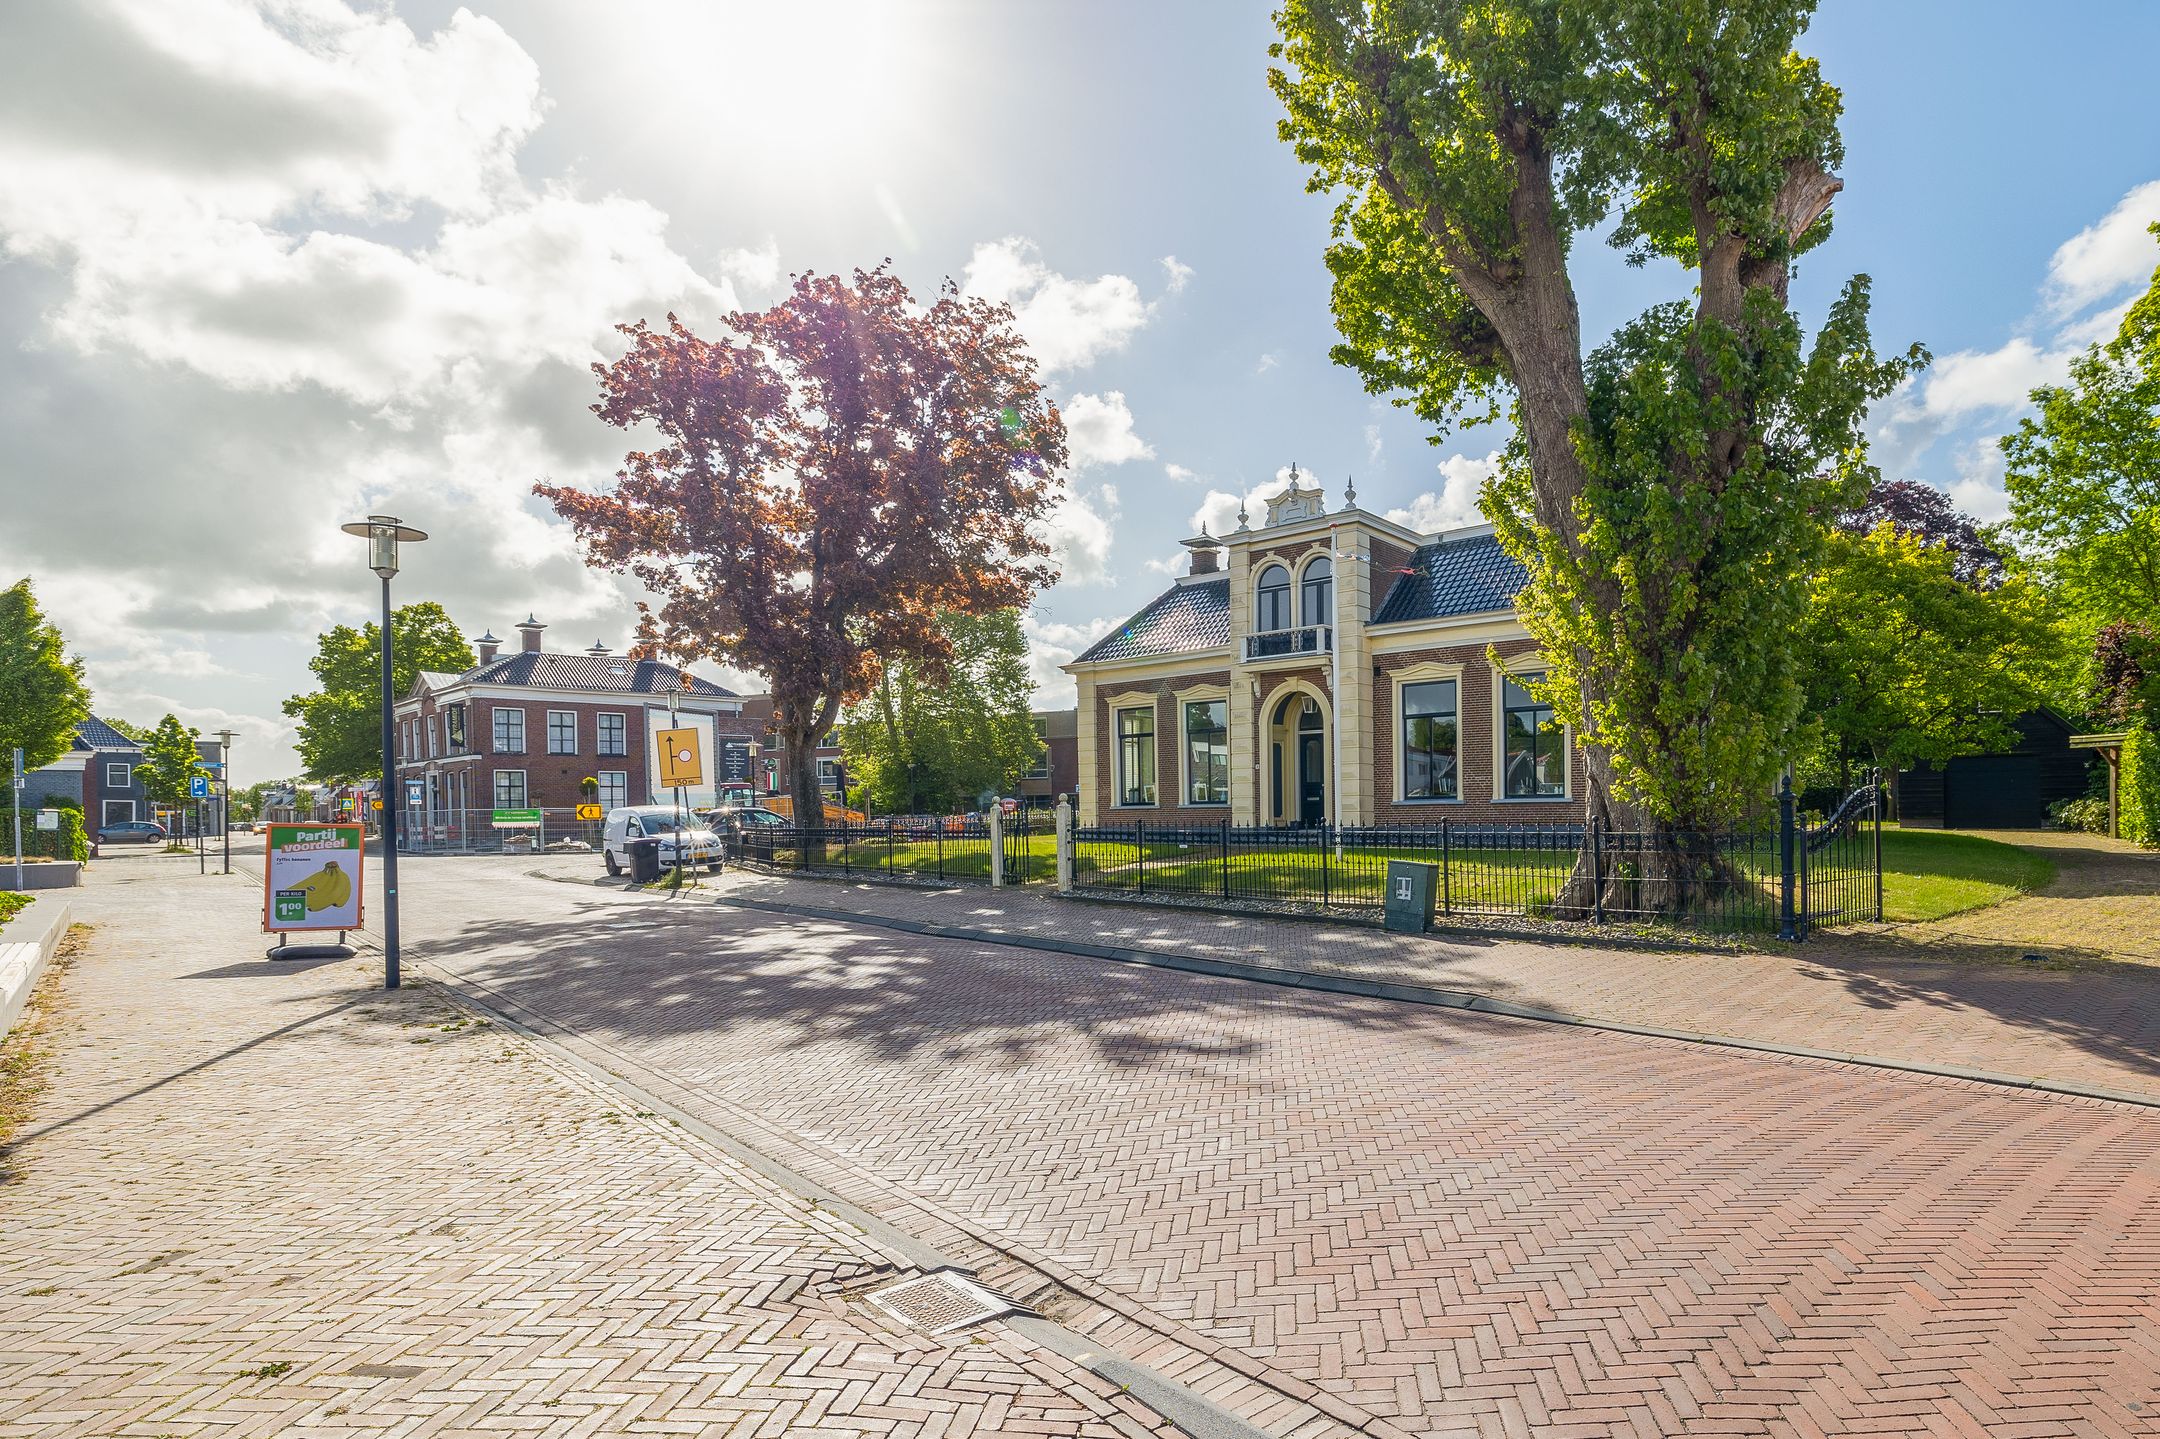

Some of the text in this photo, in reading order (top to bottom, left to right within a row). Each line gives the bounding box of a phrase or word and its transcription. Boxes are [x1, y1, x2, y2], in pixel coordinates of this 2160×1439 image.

[194, 778, 204, 789] P
[296, 828, 336, 842] Partij
[284, 838, 345, 852] voordeel
